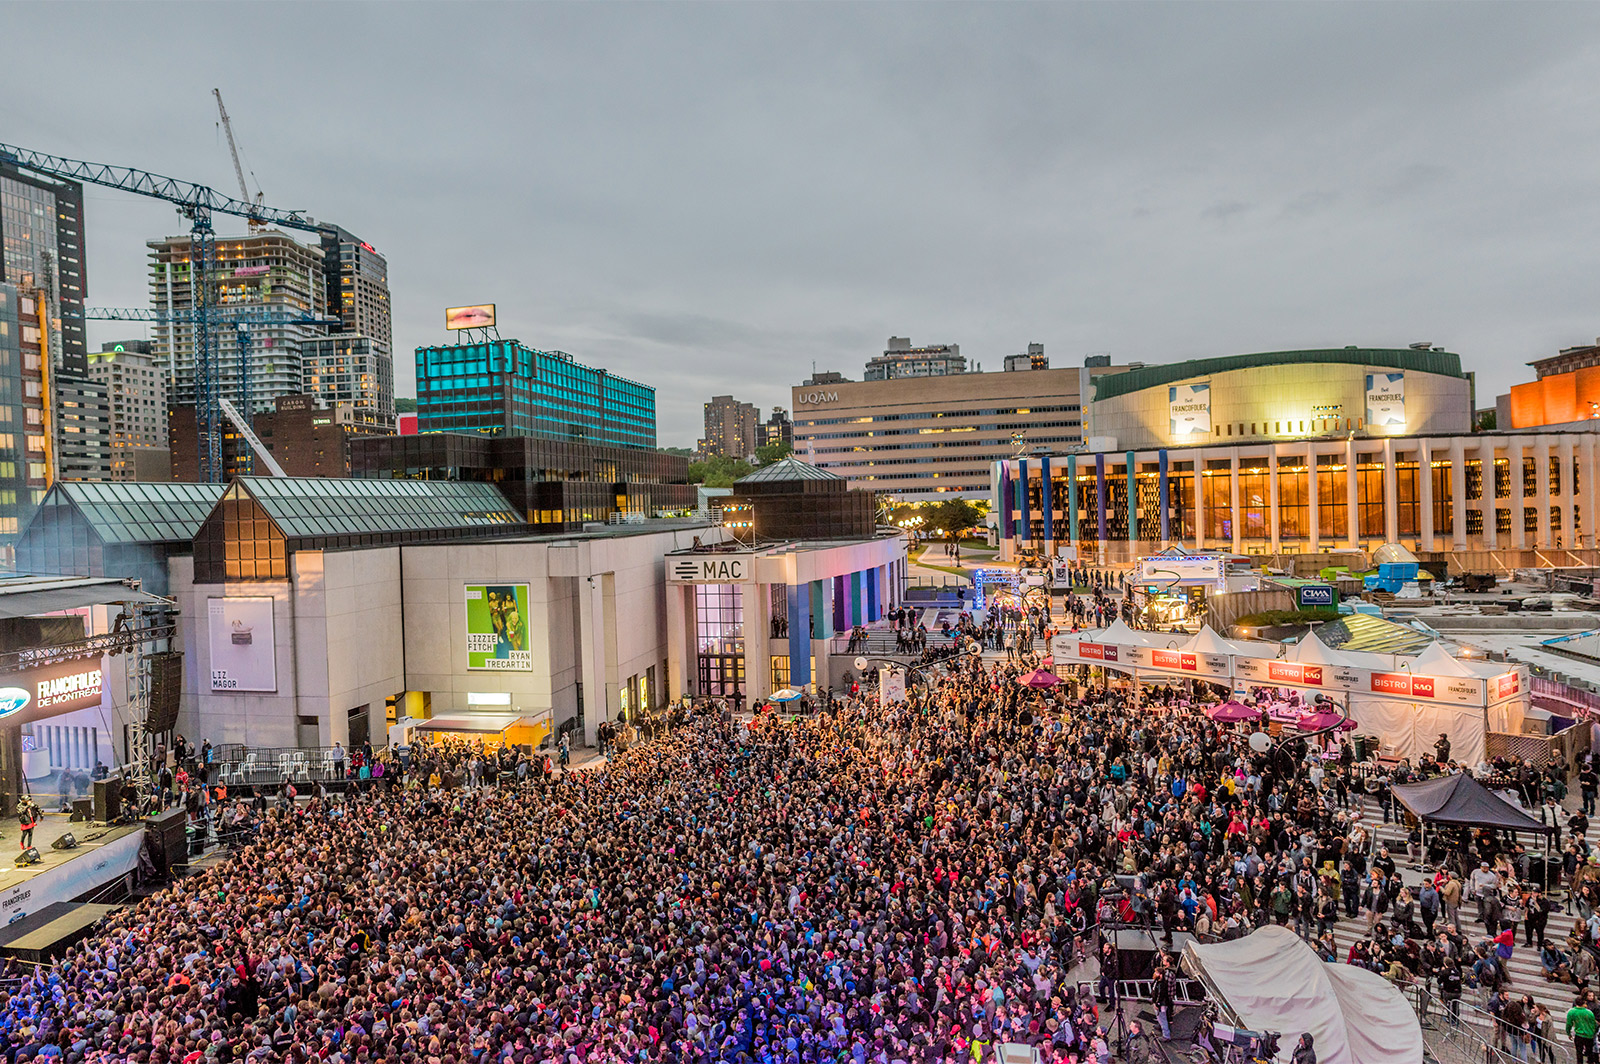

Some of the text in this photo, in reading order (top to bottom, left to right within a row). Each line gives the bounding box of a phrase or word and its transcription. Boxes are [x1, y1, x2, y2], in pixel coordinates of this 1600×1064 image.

[703, 561, 741, 579] MAC
[468, 635, 496, 643] LIZZIE
[468, 643, 492, 651] FITCH
[1080, 646, 1102, 655] BISTRO
[511, 652, 530, 660] RYAN
[1154, 655, 1178, 664] BISTRO
[487, 660, 530, 669] TRECARTIN
[212, 671, 227, 680] LIZ
[1271, 667, 1299, 678] BISTRO
[37, 669, 102, 699] FRANCOFOLIES
[212, 680, 237, 688] MAGOR
[1374, 678, 1407, 689] BISTRO
[37, 686, 102, 708] DE MONTRÉAL
